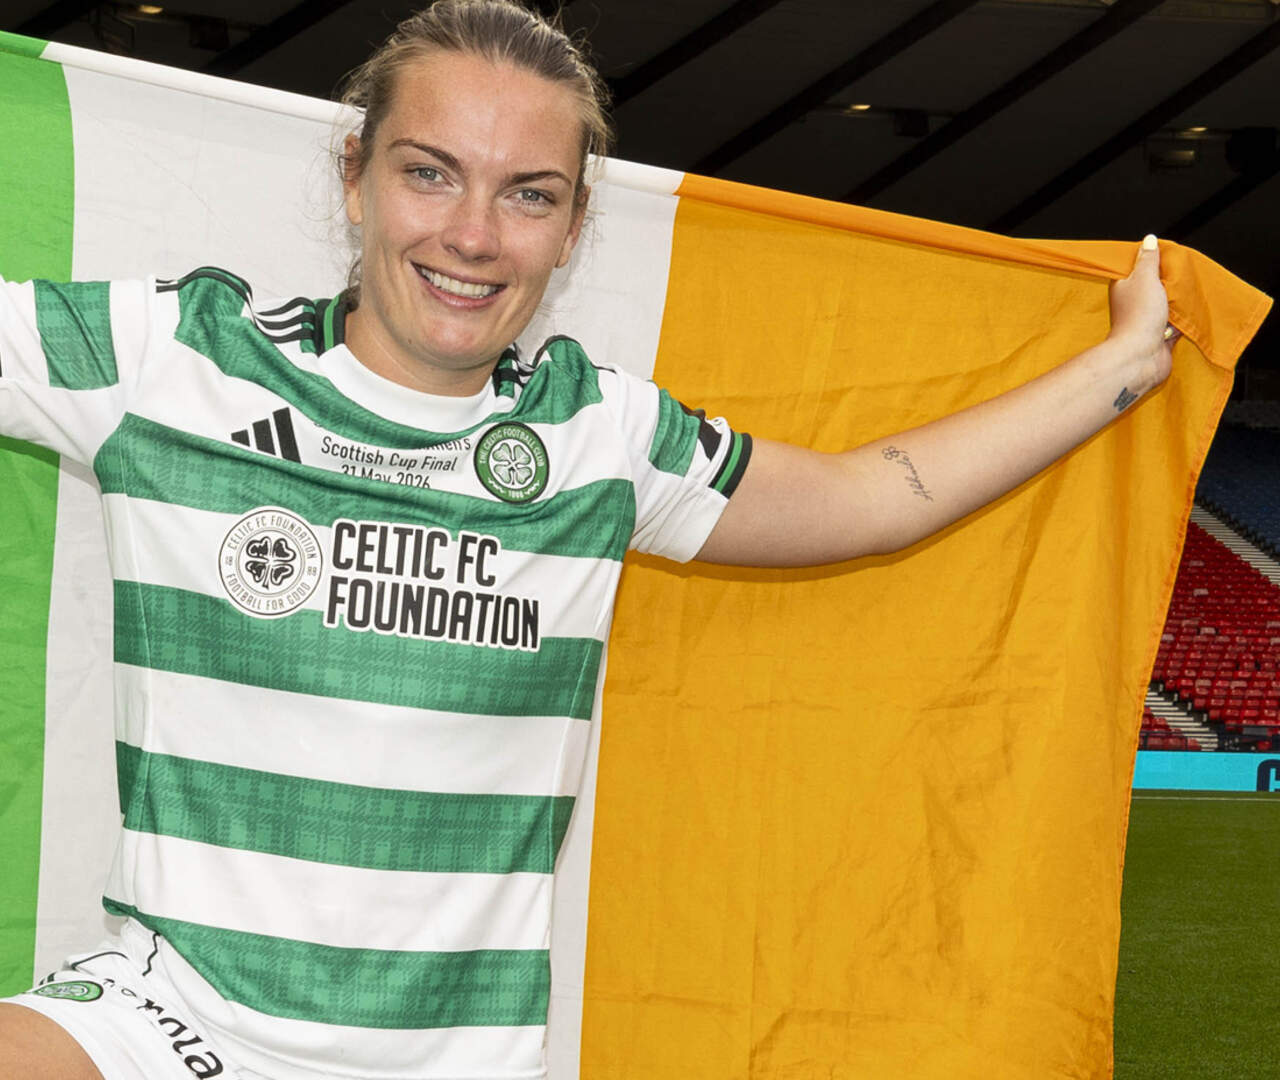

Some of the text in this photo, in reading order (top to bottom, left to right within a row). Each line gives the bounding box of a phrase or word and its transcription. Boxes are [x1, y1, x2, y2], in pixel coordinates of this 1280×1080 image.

[321, 435, 458, 472] Scottish Cup Final
[503, 428, 535, 450] FOOTBALL
[227, 514, 318, 560] CELTIC FC FOUNDATION
[332, 522, 499, 588] CELTIC FC
[225, 573, 311, 611] FOOTBALL FOR GOOD
[327, 575, 539, 649] FOUNDATION
